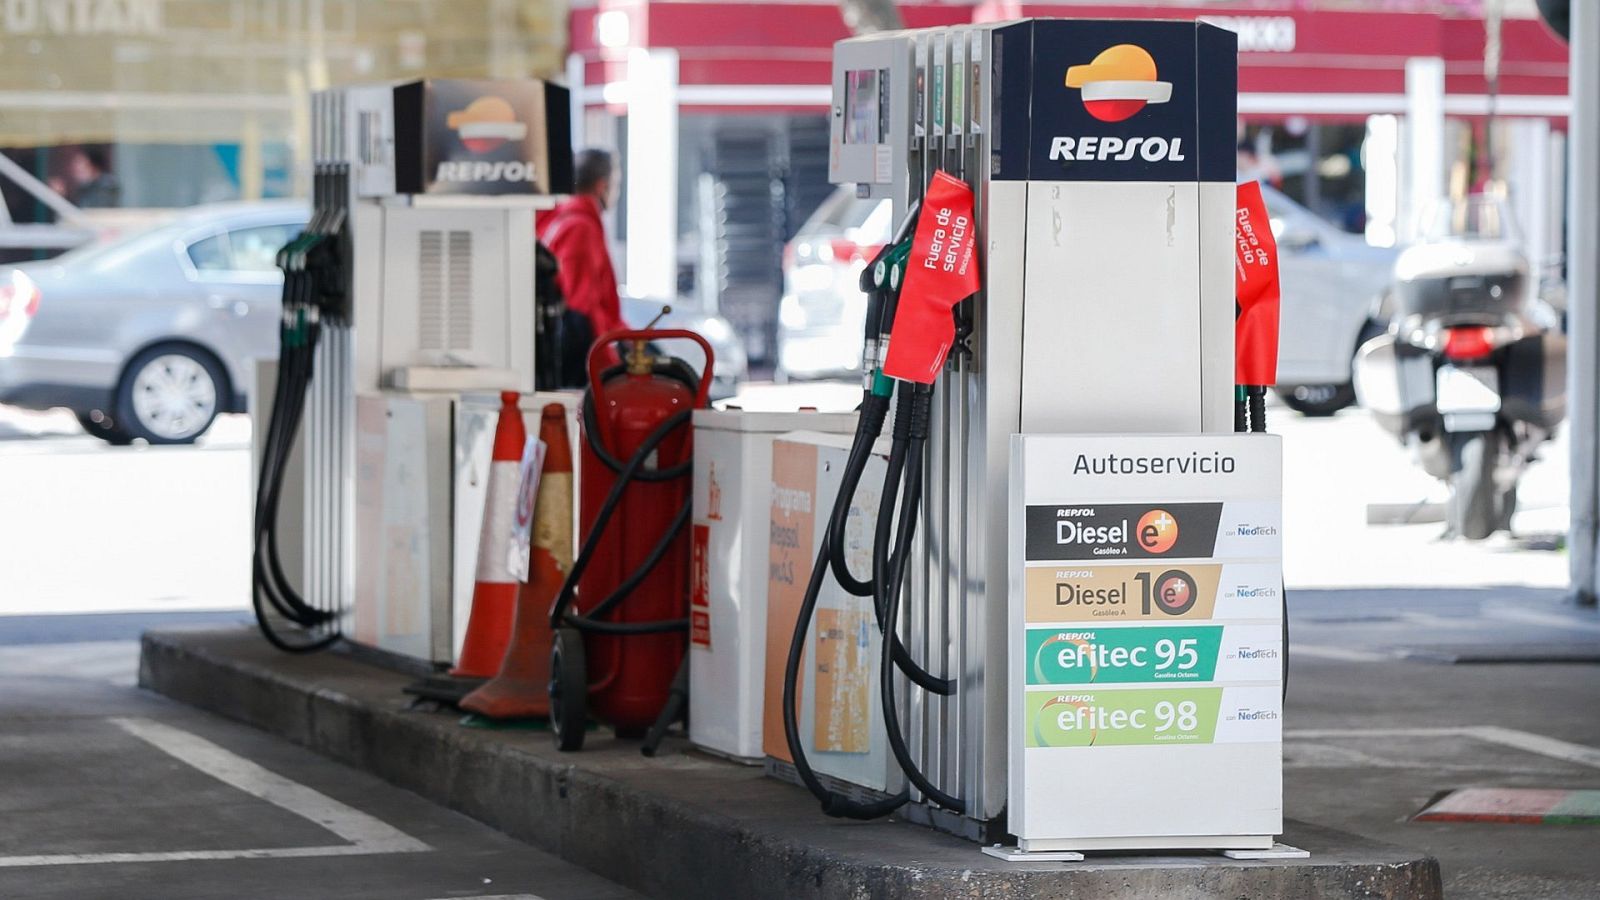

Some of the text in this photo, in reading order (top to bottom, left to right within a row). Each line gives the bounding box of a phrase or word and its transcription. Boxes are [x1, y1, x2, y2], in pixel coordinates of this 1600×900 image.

[1049, 136, 1185, 162] REPSOL
[435, 160, 537, 182] REPSOL
[924, 207, 952, 270] Fuera de
[943, 215, 968, 272] servicio
[1236, 208, 1258, 245] Fuera
[1256, 248, 1269, 266] de
[1073, 451, 1236, 475] Autoservicio
[1057, 508, 1095, 517] REPSOL
[1056, 519, 1128, 545] Diesel
[1056, 570, 1094, 578] REPSOL
[1056, 582, 1126, 605] Diesel
[1134, 569, 1198, 616] 10
[1057, 632, 1096, 640] REPSOL
[1057, 639, 1198, 670] efitec 95
[1057, 701, 1198, 732] efitec 98
